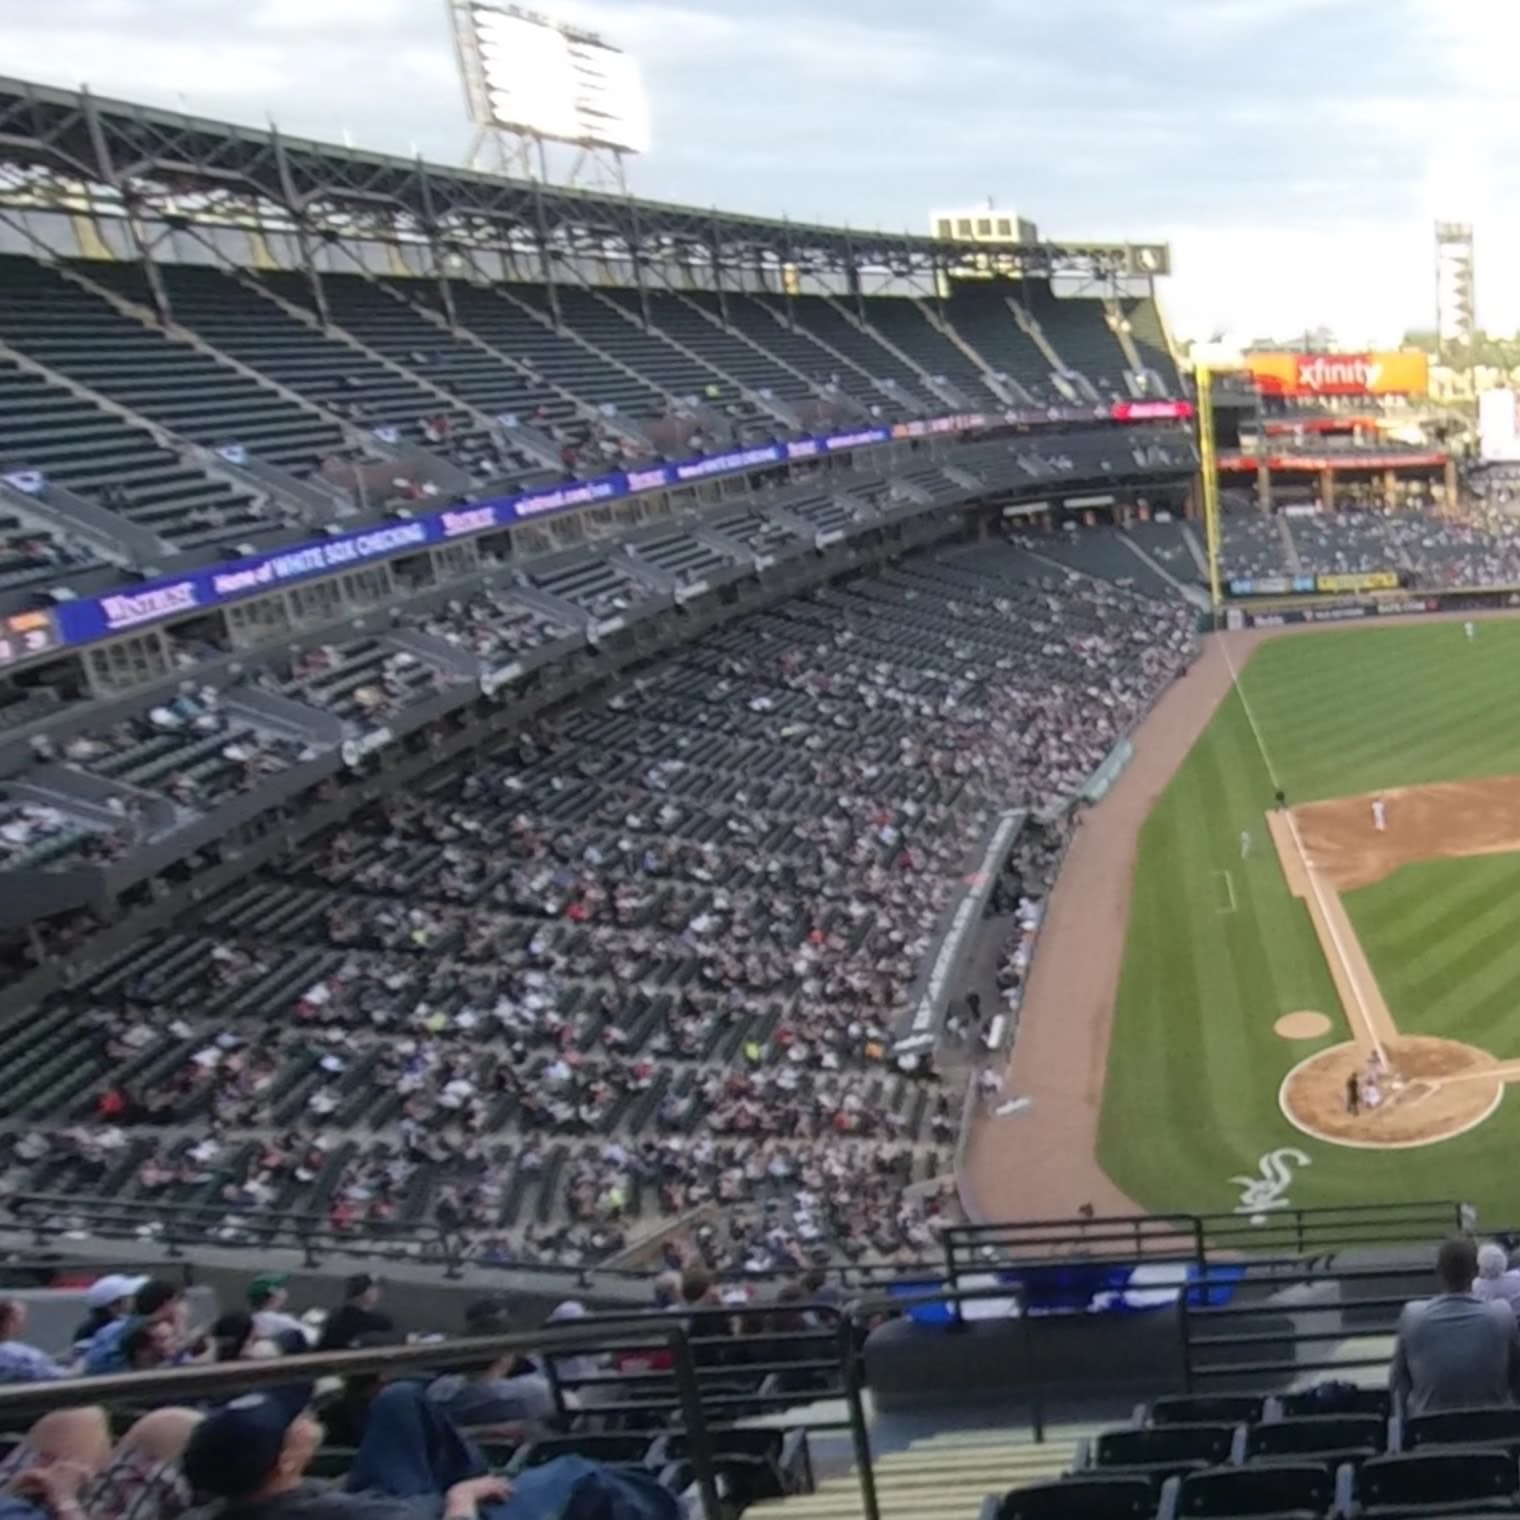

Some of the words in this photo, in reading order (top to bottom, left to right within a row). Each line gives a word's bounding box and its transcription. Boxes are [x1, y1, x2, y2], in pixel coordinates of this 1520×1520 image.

[1300, 357, 1382, 391] xfinity
[272, 547, 325, 577] WHITE
[323, 539, 358, 564] SOX
